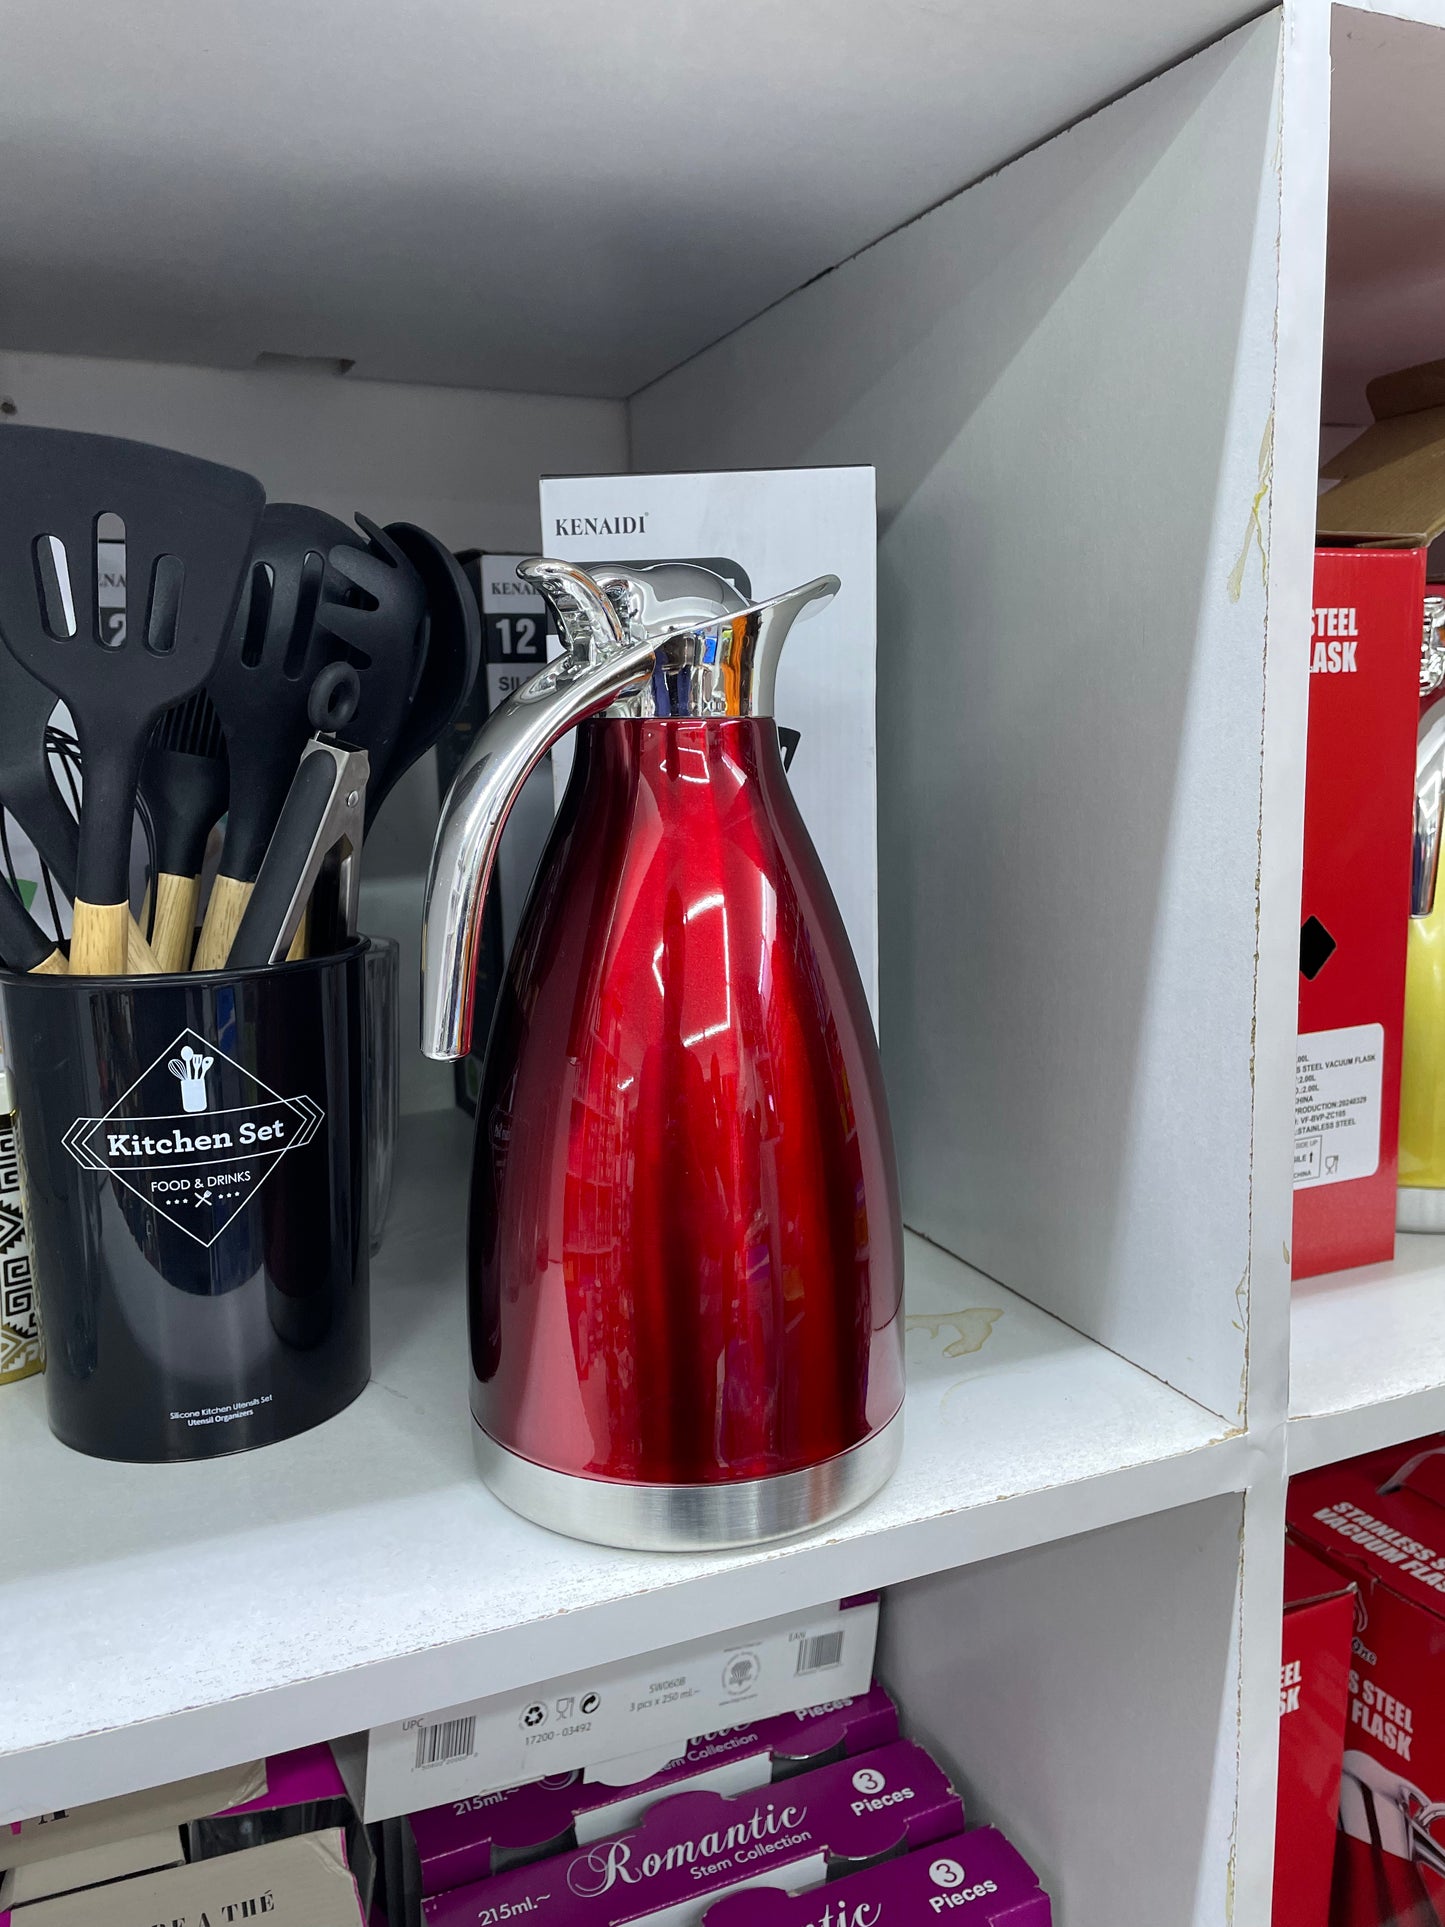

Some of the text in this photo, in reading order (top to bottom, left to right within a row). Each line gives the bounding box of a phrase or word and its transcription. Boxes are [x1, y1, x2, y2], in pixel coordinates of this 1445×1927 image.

[555, 516, 646, 537] KENAIDI
[492, 581, 540, 596] KENA
[495, 617, 537, 655] 12
[1309, 641, 1358, 673] ASK
[1302, 1063, 1324, 1073] STEEL
[1325, 1057, 1354, 1069] VACUUM
[1355, 1054, 1376, 1065] FLASK
[107, 1119, 285, 1157] Kitchen Set
[1335, 1118, 1356, 1128] STEEL
[150, 1170, 252, 1193] FOOD & DRINKS
[169, 1394, 273, 1420] Silicone Kitchen Utensils Set
[187, 1408, 254, 1427] Utensil Organizers
[1312, 1507, 1409, 1564] VACUUM
[1331, 1501, 1437, 1561] STAINLESS
[1362, 1679, 1414, 1734] STEEL
[402, 1718, 425, 1731] UPC
[525, 1730, 555, 1746] 17200
[562, 1722, 592, 1738] 03492
[1351, 1697, 1413, 1762] FLASK
[687, 1731, 760, 1762] Collection
[850, 1786, 916, 1817] Pieces
[566, 1803, 809, 1898] Romantic
[689, 1829, 813, 1880] Stem Collection
[935, 1862, 958, 1884] 3
[221, 1888, 275, 1923] THÉ
[928, 1878, 999, 1914] Pieces
